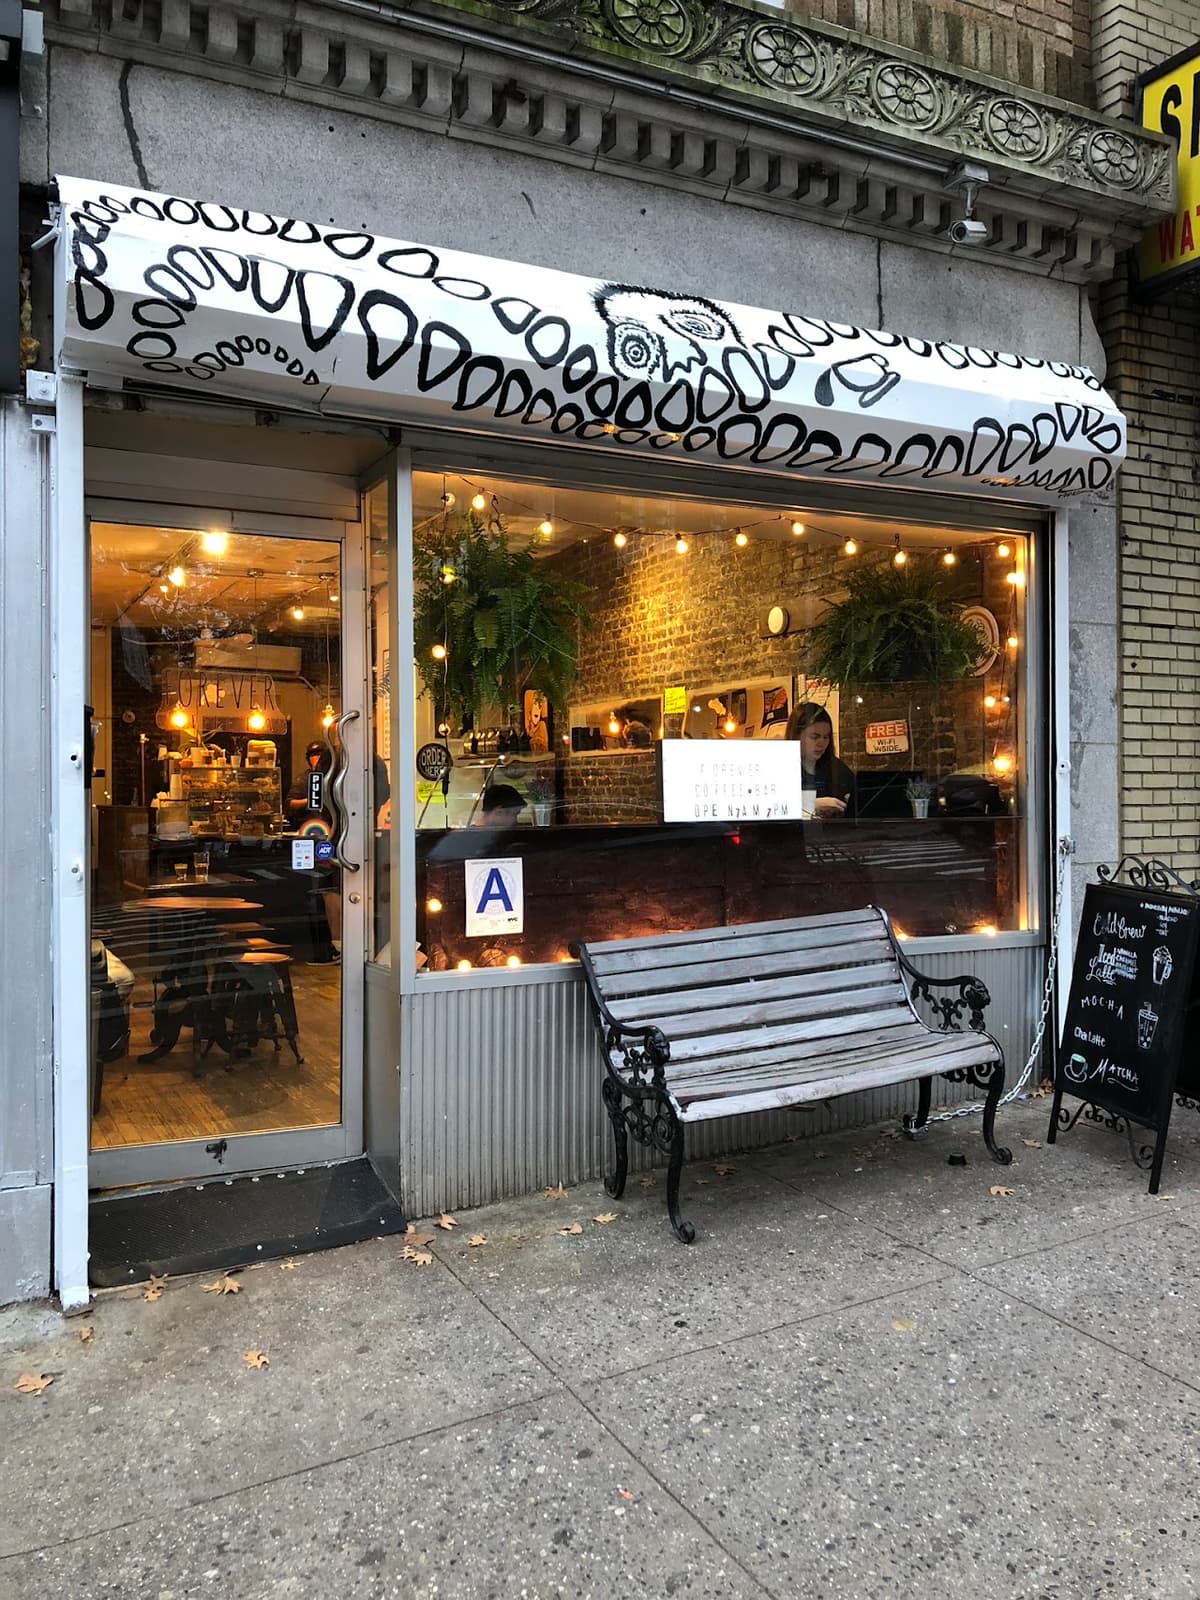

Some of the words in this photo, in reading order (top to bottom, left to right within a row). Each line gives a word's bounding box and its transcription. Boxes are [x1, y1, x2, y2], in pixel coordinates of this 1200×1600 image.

[164, 670, 275, 711] FOREVER
[869, 723, 905, 738] FREE
[421, 747, 448, 767] ORDER
[700, 763, 760, 777] FOREVER
[311, 774, 320, 808] PULL
[694, 783, 744, 798] COFFEE
[754, 783, 777, 797] BAR
[318, 845, 332, 855] ADT
[475, 867, 514, 914] A
[1093, 911, 1118, 937] Cold
[1117, 916, 1148, 939] Brew
[1097, 943, 1117, 967] Iced
